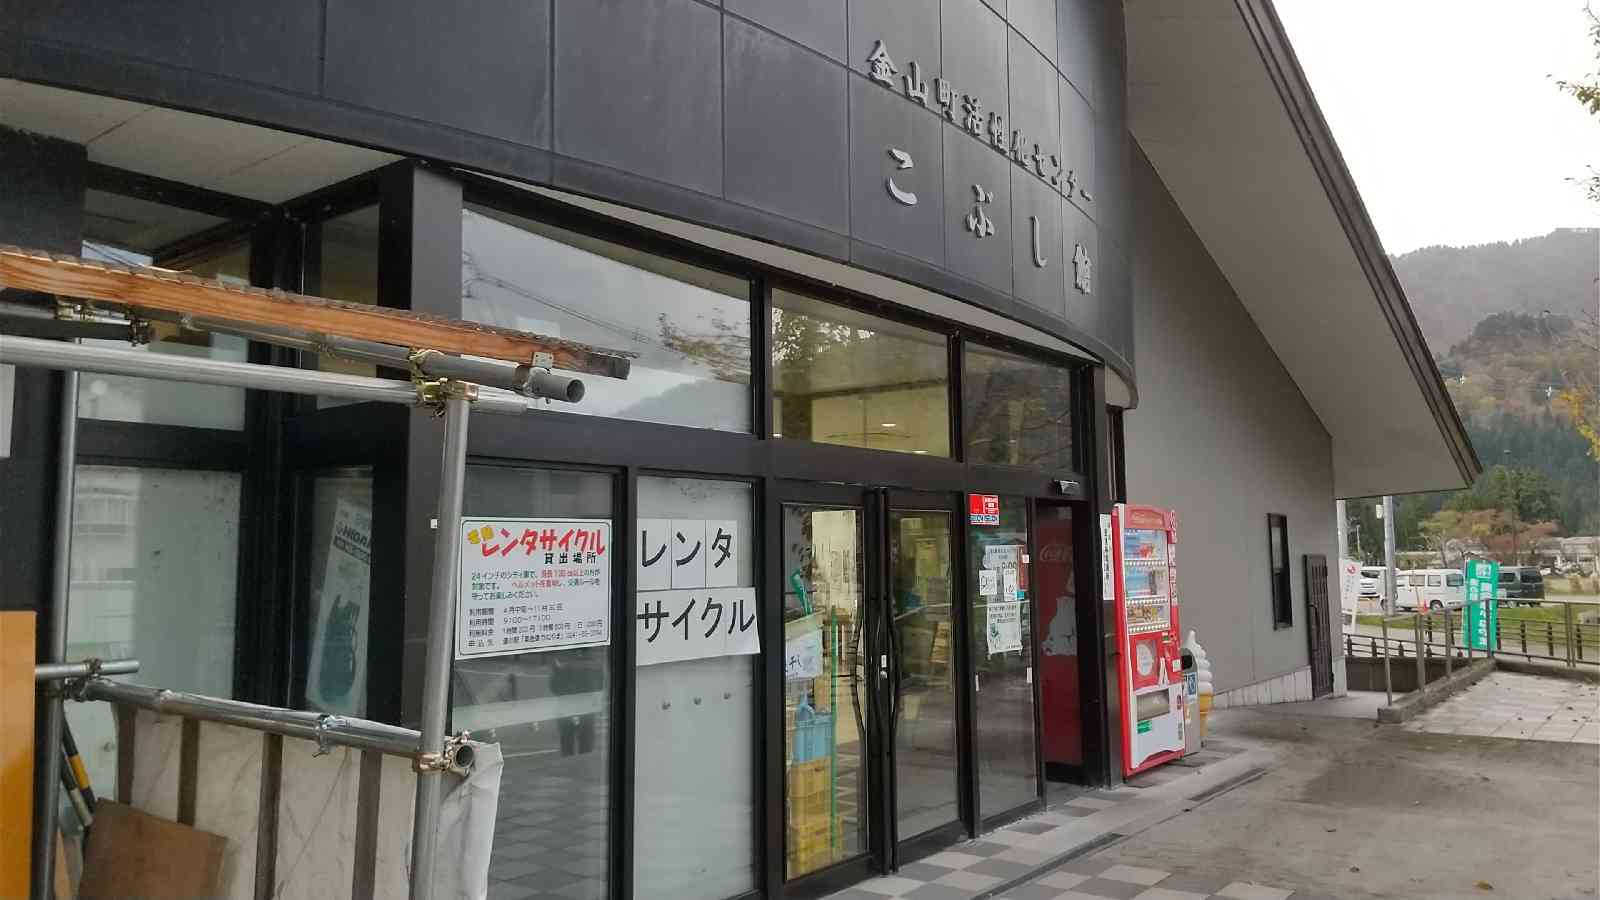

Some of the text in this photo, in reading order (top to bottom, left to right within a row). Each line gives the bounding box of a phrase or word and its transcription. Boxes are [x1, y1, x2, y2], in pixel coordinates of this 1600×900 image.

[886, 147, 1092, 295] こぶし館
[481, 527, 606, 558] レンタサイクル
[543, 551, 597, 565] 貸出場所
[641, 529, 733, 569] レンタ
[637, 597, 756, 643] サイクル
